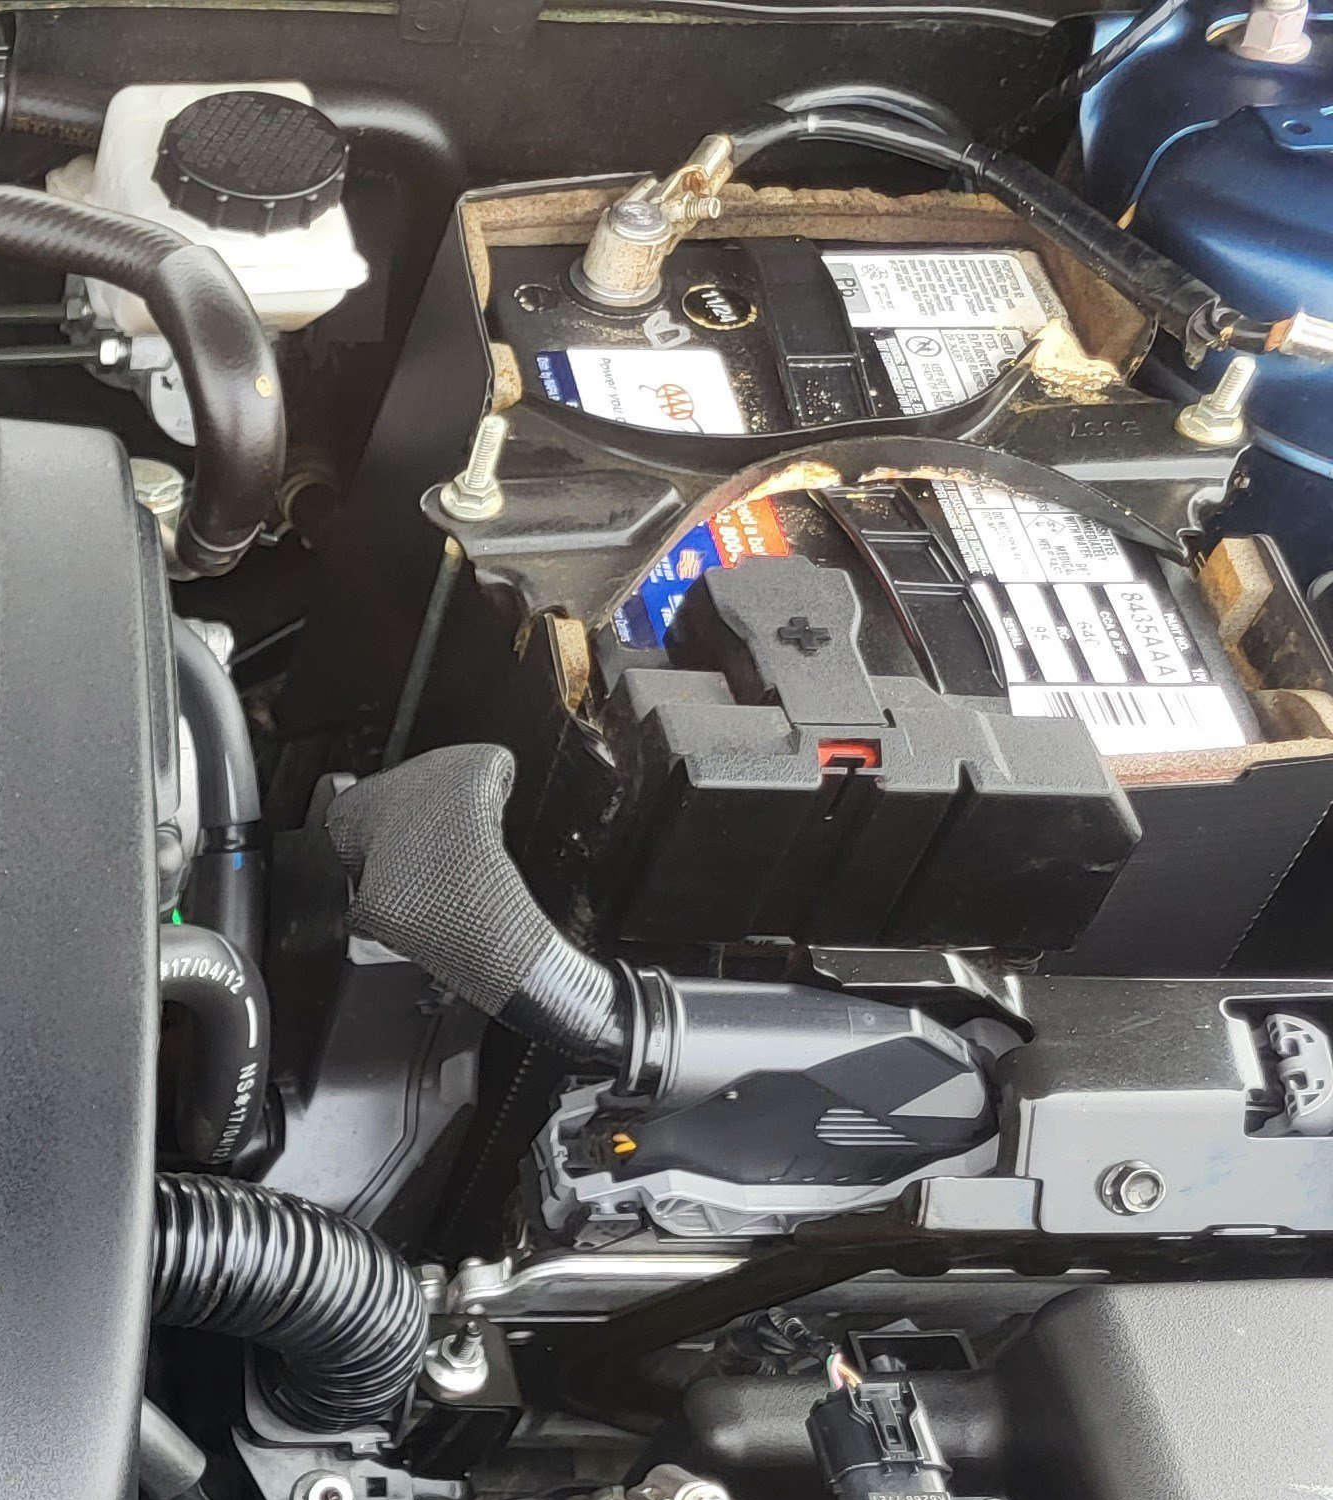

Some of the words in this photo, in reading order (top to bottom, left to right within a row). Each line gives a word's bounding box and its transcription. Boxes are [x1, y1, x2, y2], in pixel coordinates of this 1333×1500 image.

[835, 277, 856, 298] Pb
[700, 290, 738, 323] 11/24
[1118, 591, 1179, 676] 8435AAA
[1162, 613, 1184, 635] PART
